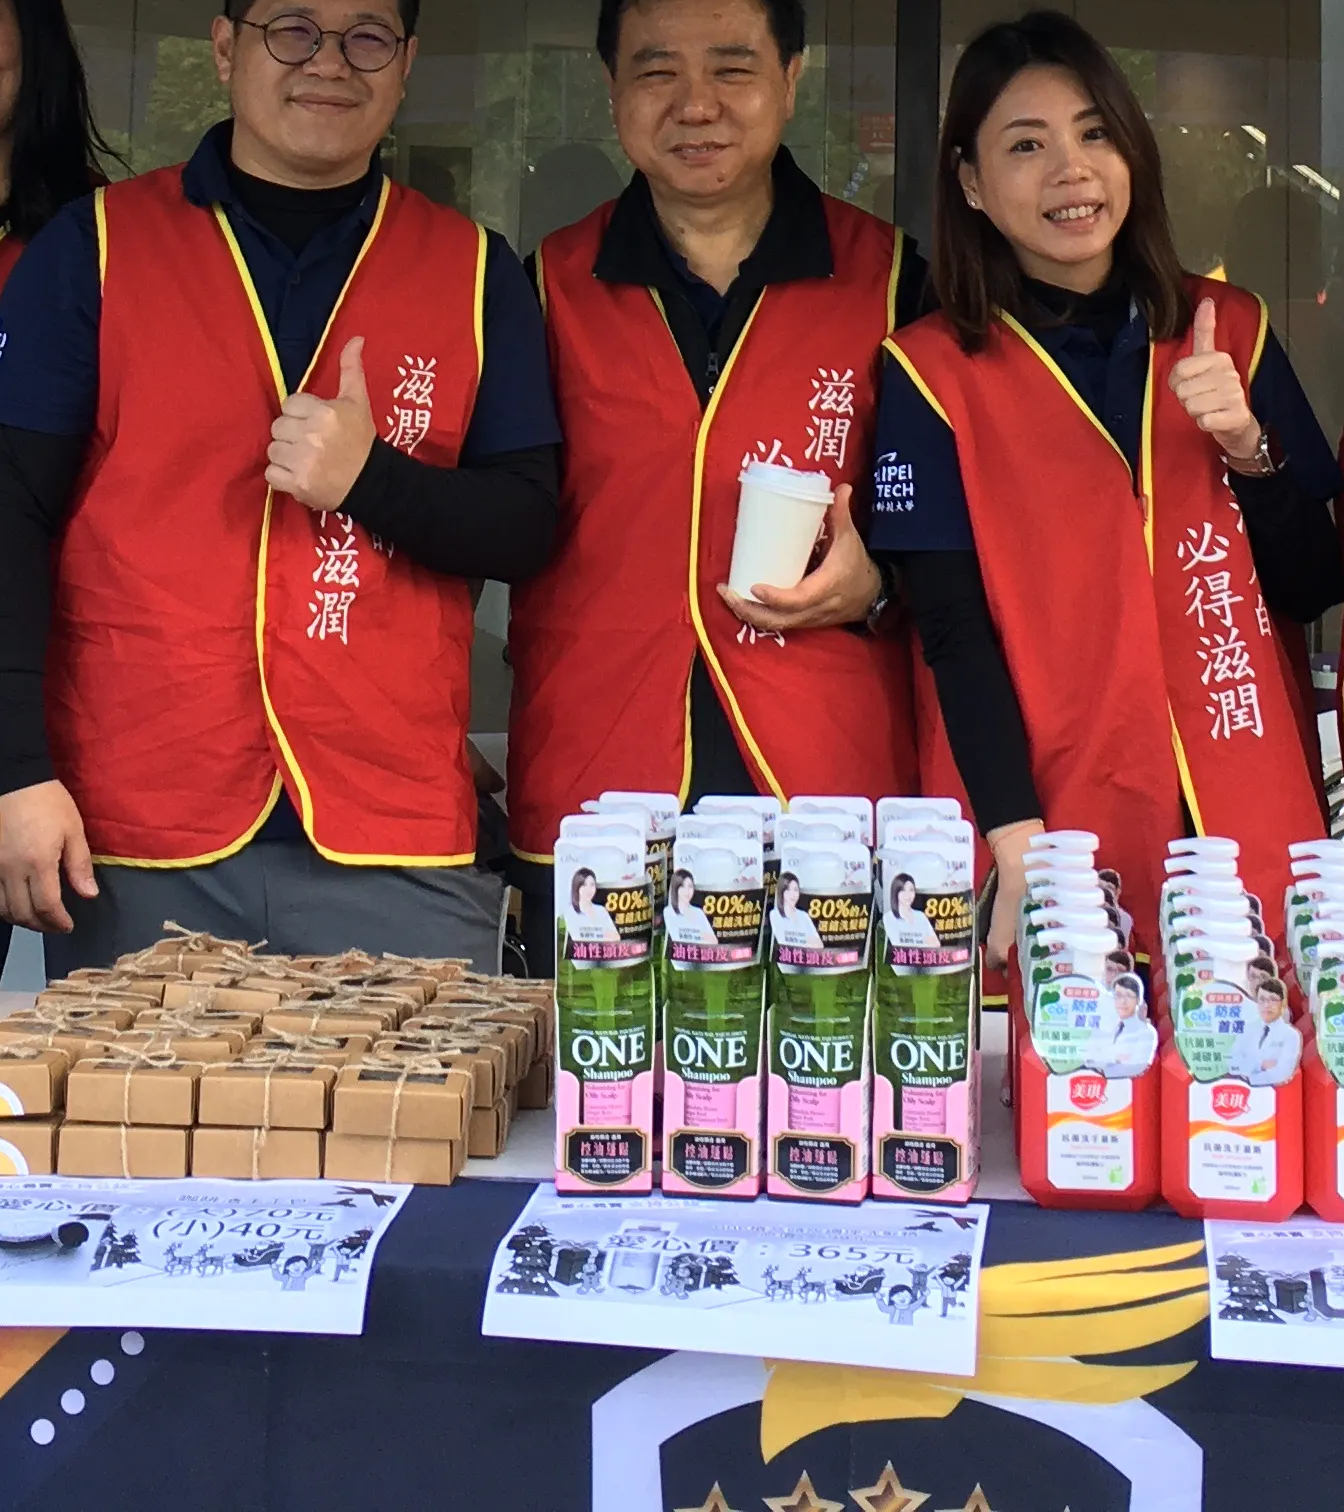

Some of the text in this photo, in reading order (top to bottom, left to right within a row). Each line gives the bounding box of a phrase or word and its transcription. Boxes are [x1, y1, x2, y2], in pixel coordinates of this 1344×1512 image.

[876, 482, 914, 498] TECH
[1176, 520, 1265, 741] 必得滋潤
[573, 941, 630, 959] 油性頭皮
[672, 943, 729, 962] 油性頭皮
[779, 947, 834, 966] 油性頭皮
[892, 948, 951, 965] 油性頭皮
[1072, 1000, 1098, 1013] 防疫
[1214, 1005, 1241, 1018] 防疫
[1075, 1014, 1101, 1028] 首選
[1218, 1020, 1245, 1034] 首選
[572, 1032, 646, 1068] ONE
[673, 1033, 748, 1069] ONE
[779, 1037, 854, 1073] ONE
[890, 1038, 966, 1073] ONE
[583, 1067, 633, 1082] Shampoo
[681, 1066, 731, 1083] Shampoo
[787, 1071, 838, 1088] Shampoo
[901, 1072, 953, 1088] Shampoo
[1072, 1083, 1105, 1099] 美琪
[1214, 1093, 1246, 1108] 美琪
[152, 1218, 330, 1243] (小)40元
